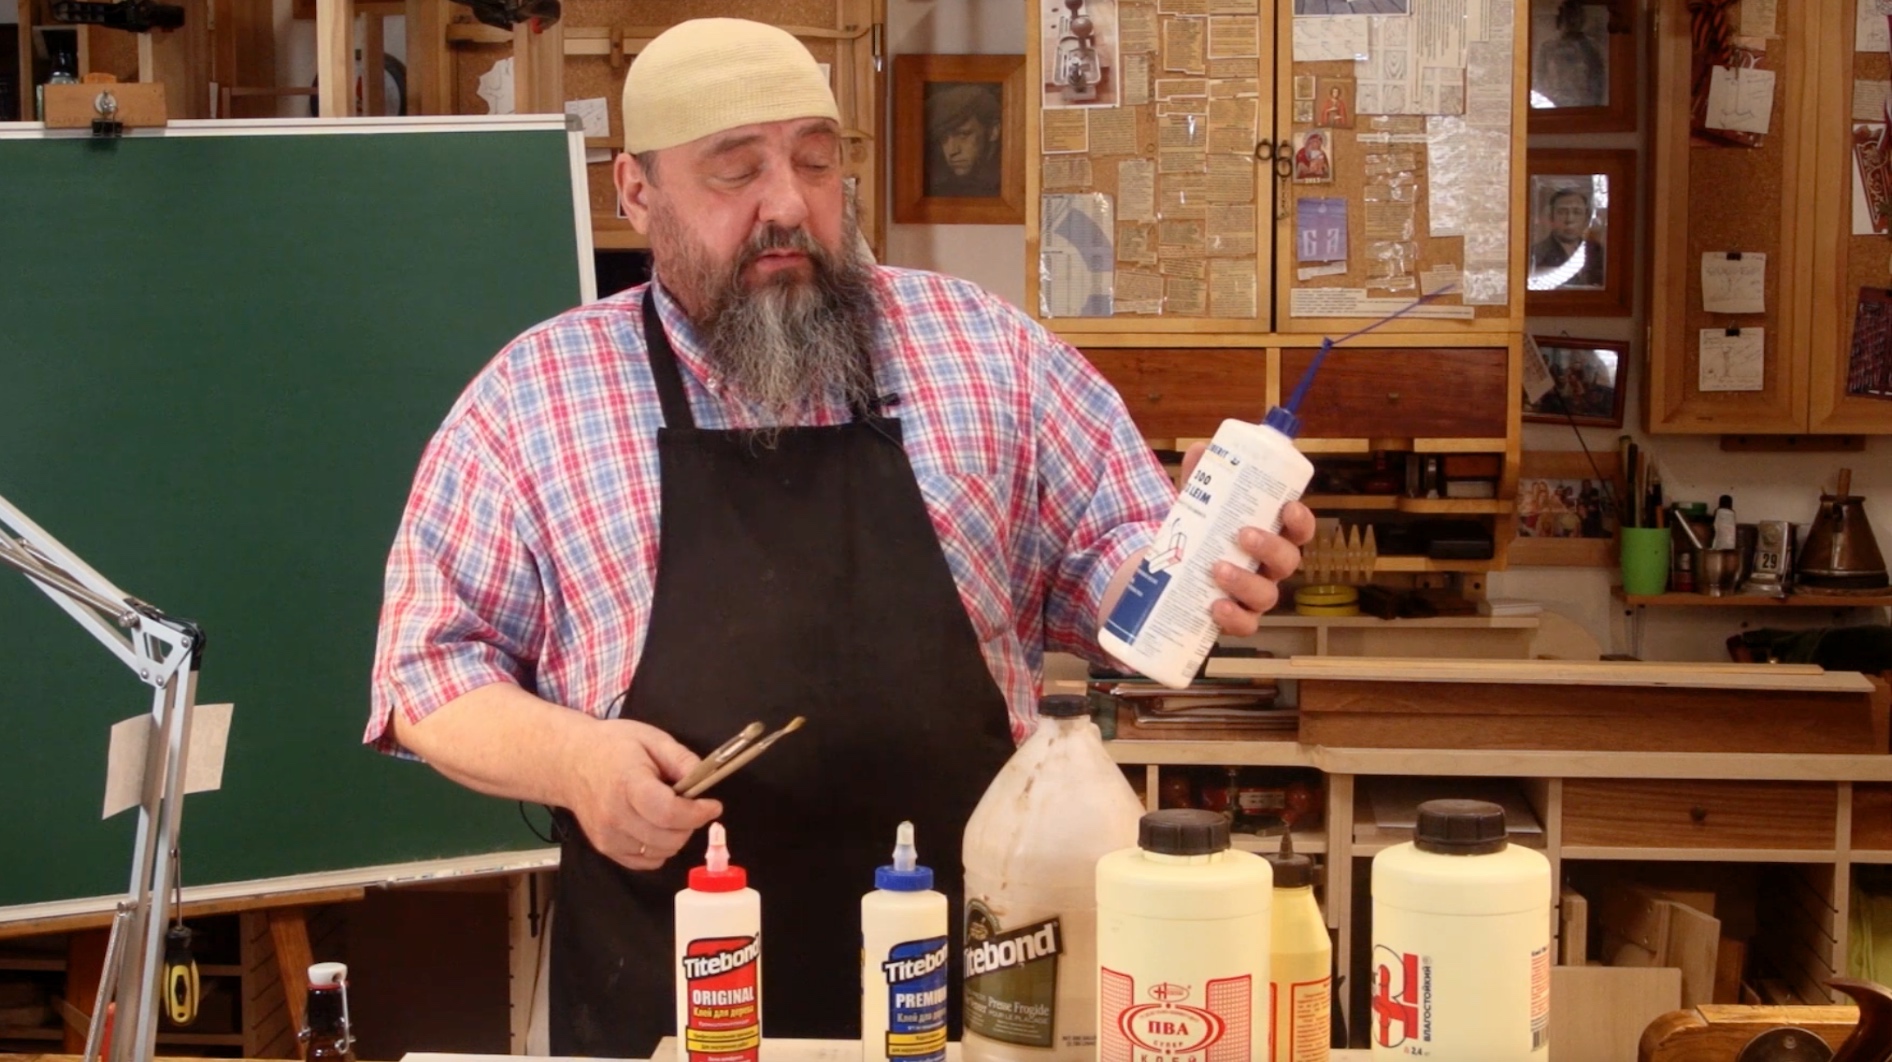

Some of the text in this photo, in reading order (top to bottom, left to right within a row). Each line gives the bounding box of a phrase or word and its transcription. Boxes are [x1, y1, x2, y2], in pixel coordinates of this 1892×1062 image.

[1762, 553, 1778, 569] 29
[692, 986, 754, 1005] ORIGINAL
[1422, 966, 1431, 1042] ВЛАГОСТОЙКИЙ
[1148, 1021, 1189, 1036] ПВА
